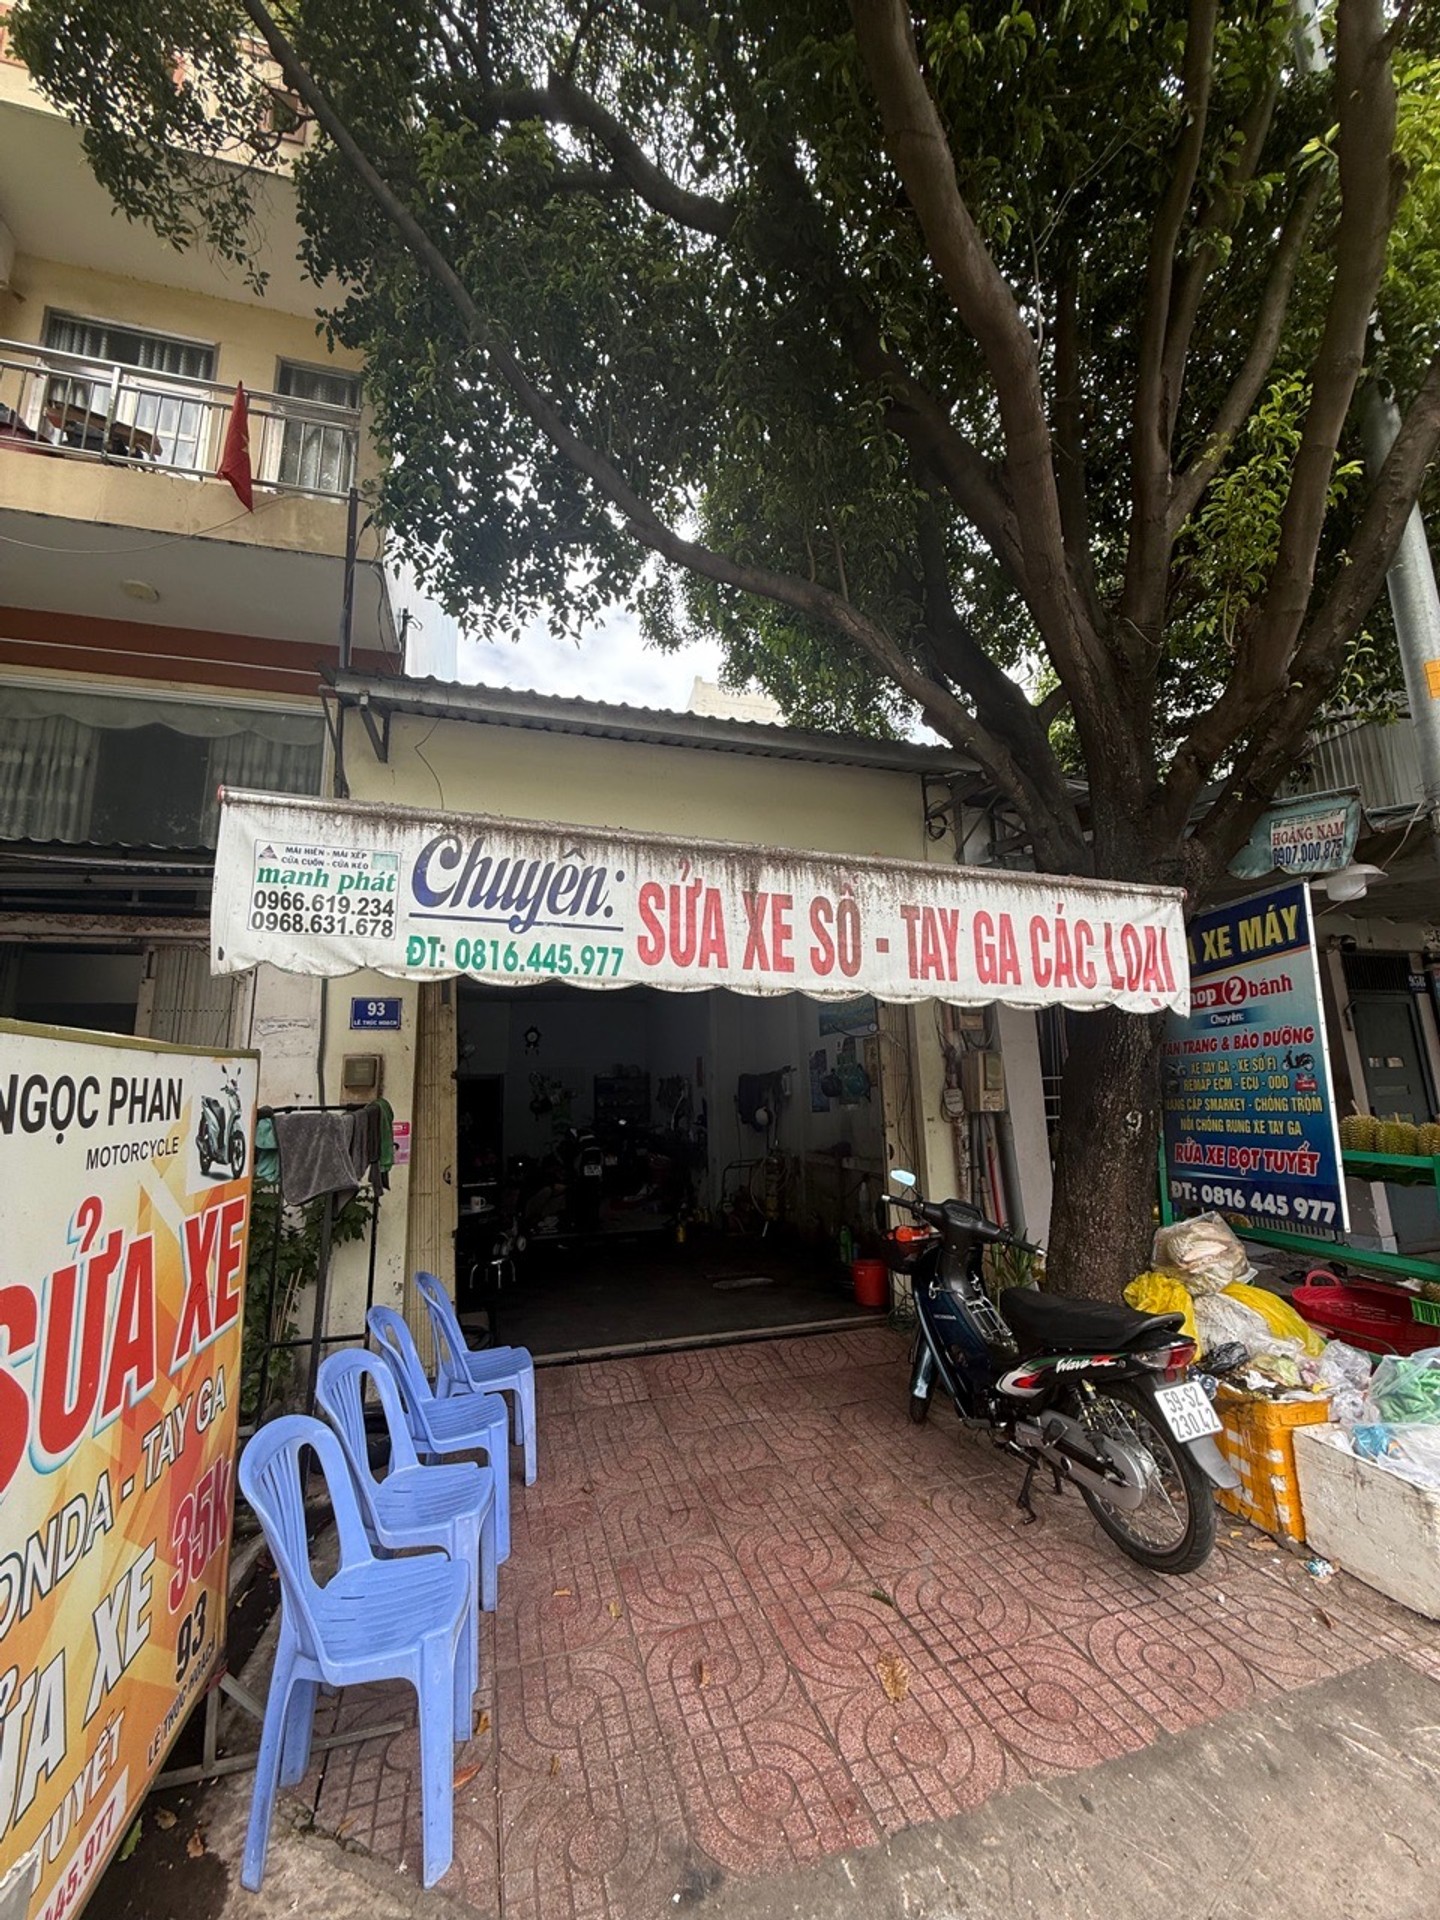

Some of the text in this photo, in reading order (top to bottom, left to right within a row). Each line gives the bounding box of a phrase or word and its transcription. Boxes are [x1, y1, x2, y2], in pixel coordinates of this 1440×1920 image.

[1316, 821, 1344, 840] NAM
[256, 867, 396, 895] mạnh phát
[410, 833, 625, 935] Chuyên:
[253, 889, 395, 918] 0966.619.234
[251, 911, 394, 938] 0968.631.678
[636, 858, 729, 969] SỬA
[742, 891, 795, 974] XE
[875, 937, 890, 954] -
[900, 904, 960, 982] TAY
[973, 910, 1022, 986] GA
[1030, 903, 1097, 990] CÁC
[1103, 921, 1176, 1006] LOẠI
[1201, 925, 1233, 962] XE
[1238, 904, 1299, 953] MÁY
[406, 935, 625, 976] ĐT: 0816.445.977
[1229, 978, 1243, 1003] 2
[1248, 974, 1293, 998] bánh
[367, 1001, 385, 1016] 93
[1183, 1037, 1217, 1054] TRANG
[1220, 1035, 1230, 1051] &
[1263, 1024, 1315, 1047] DƯỠNG
[1238, 1059, 1249, 1072] XE
[1183, 1077, 1212, 1092] REMAP
[1213, 1077, 1233, 1091] ECM
[1240, 1076, 1259, 1090] ECU
[1269, 1075, 1289, 1090] ODO
[107, 1077, 184, 1126] PHAN
[1292, 1095, 1323, 1116] TRỘM
[1253, 1120, 1266, 1134] XE
[1268, 1120, 1285, 1135] TAY
[1287, 1121, 1303, 1136] GA
[86, 1136, 180, 1171] MOTORCYCLE
[1174, 1137, 1320, 1177] RỬA XE BỌT TUYẾT
[1171, 1180, 1336, 1223] ĐT: 0816 445 977
[172, 1197, 246, 1367] XE
[1055, 1357, 1091, 1374] Wave
[121, 1474, 135, 1502] -
[142, 1391, 194, 1491] TAY
[195, 1364, 227, 1434] GA
[1170, 1406, 1220, 1439] 230.42
[83, 1539, 157, 1731] XE
[175, 1590, 207, 1686] 93
[148, 1726, 163, 1769] LÊ
[28, 1704, 127, 1899] TUYẾT
